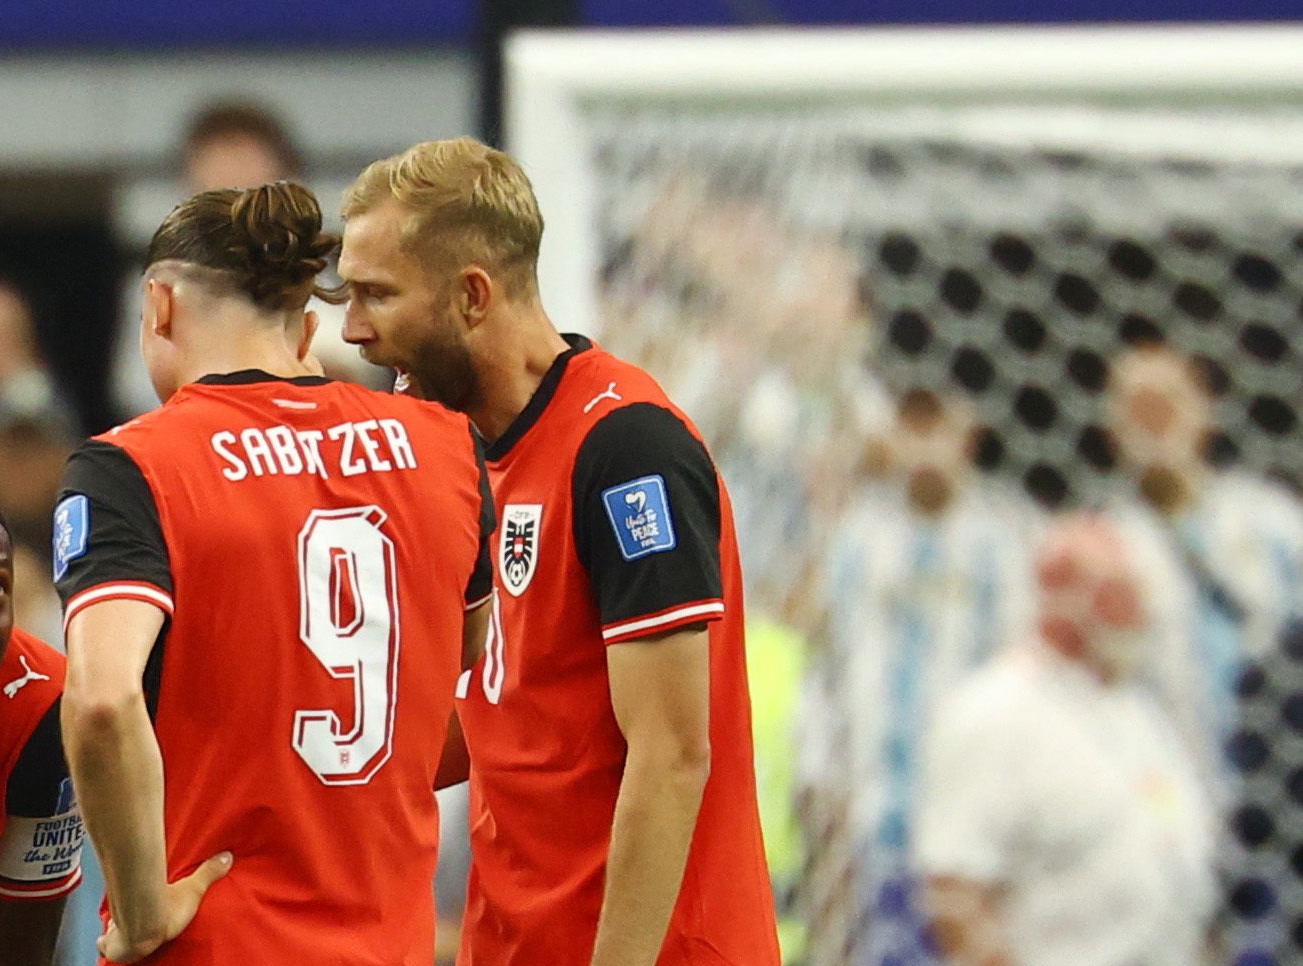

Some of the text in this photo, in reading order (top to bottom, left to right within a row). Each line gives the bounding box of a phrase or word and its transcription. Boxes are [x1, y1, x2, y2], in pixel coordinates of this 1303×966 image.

[211, 418, 417, 481] SABITZER
[631, 522, 659, 542] PEACE
[291, 505, 401, 786] 9
[455, 587, 505, 705] 0
